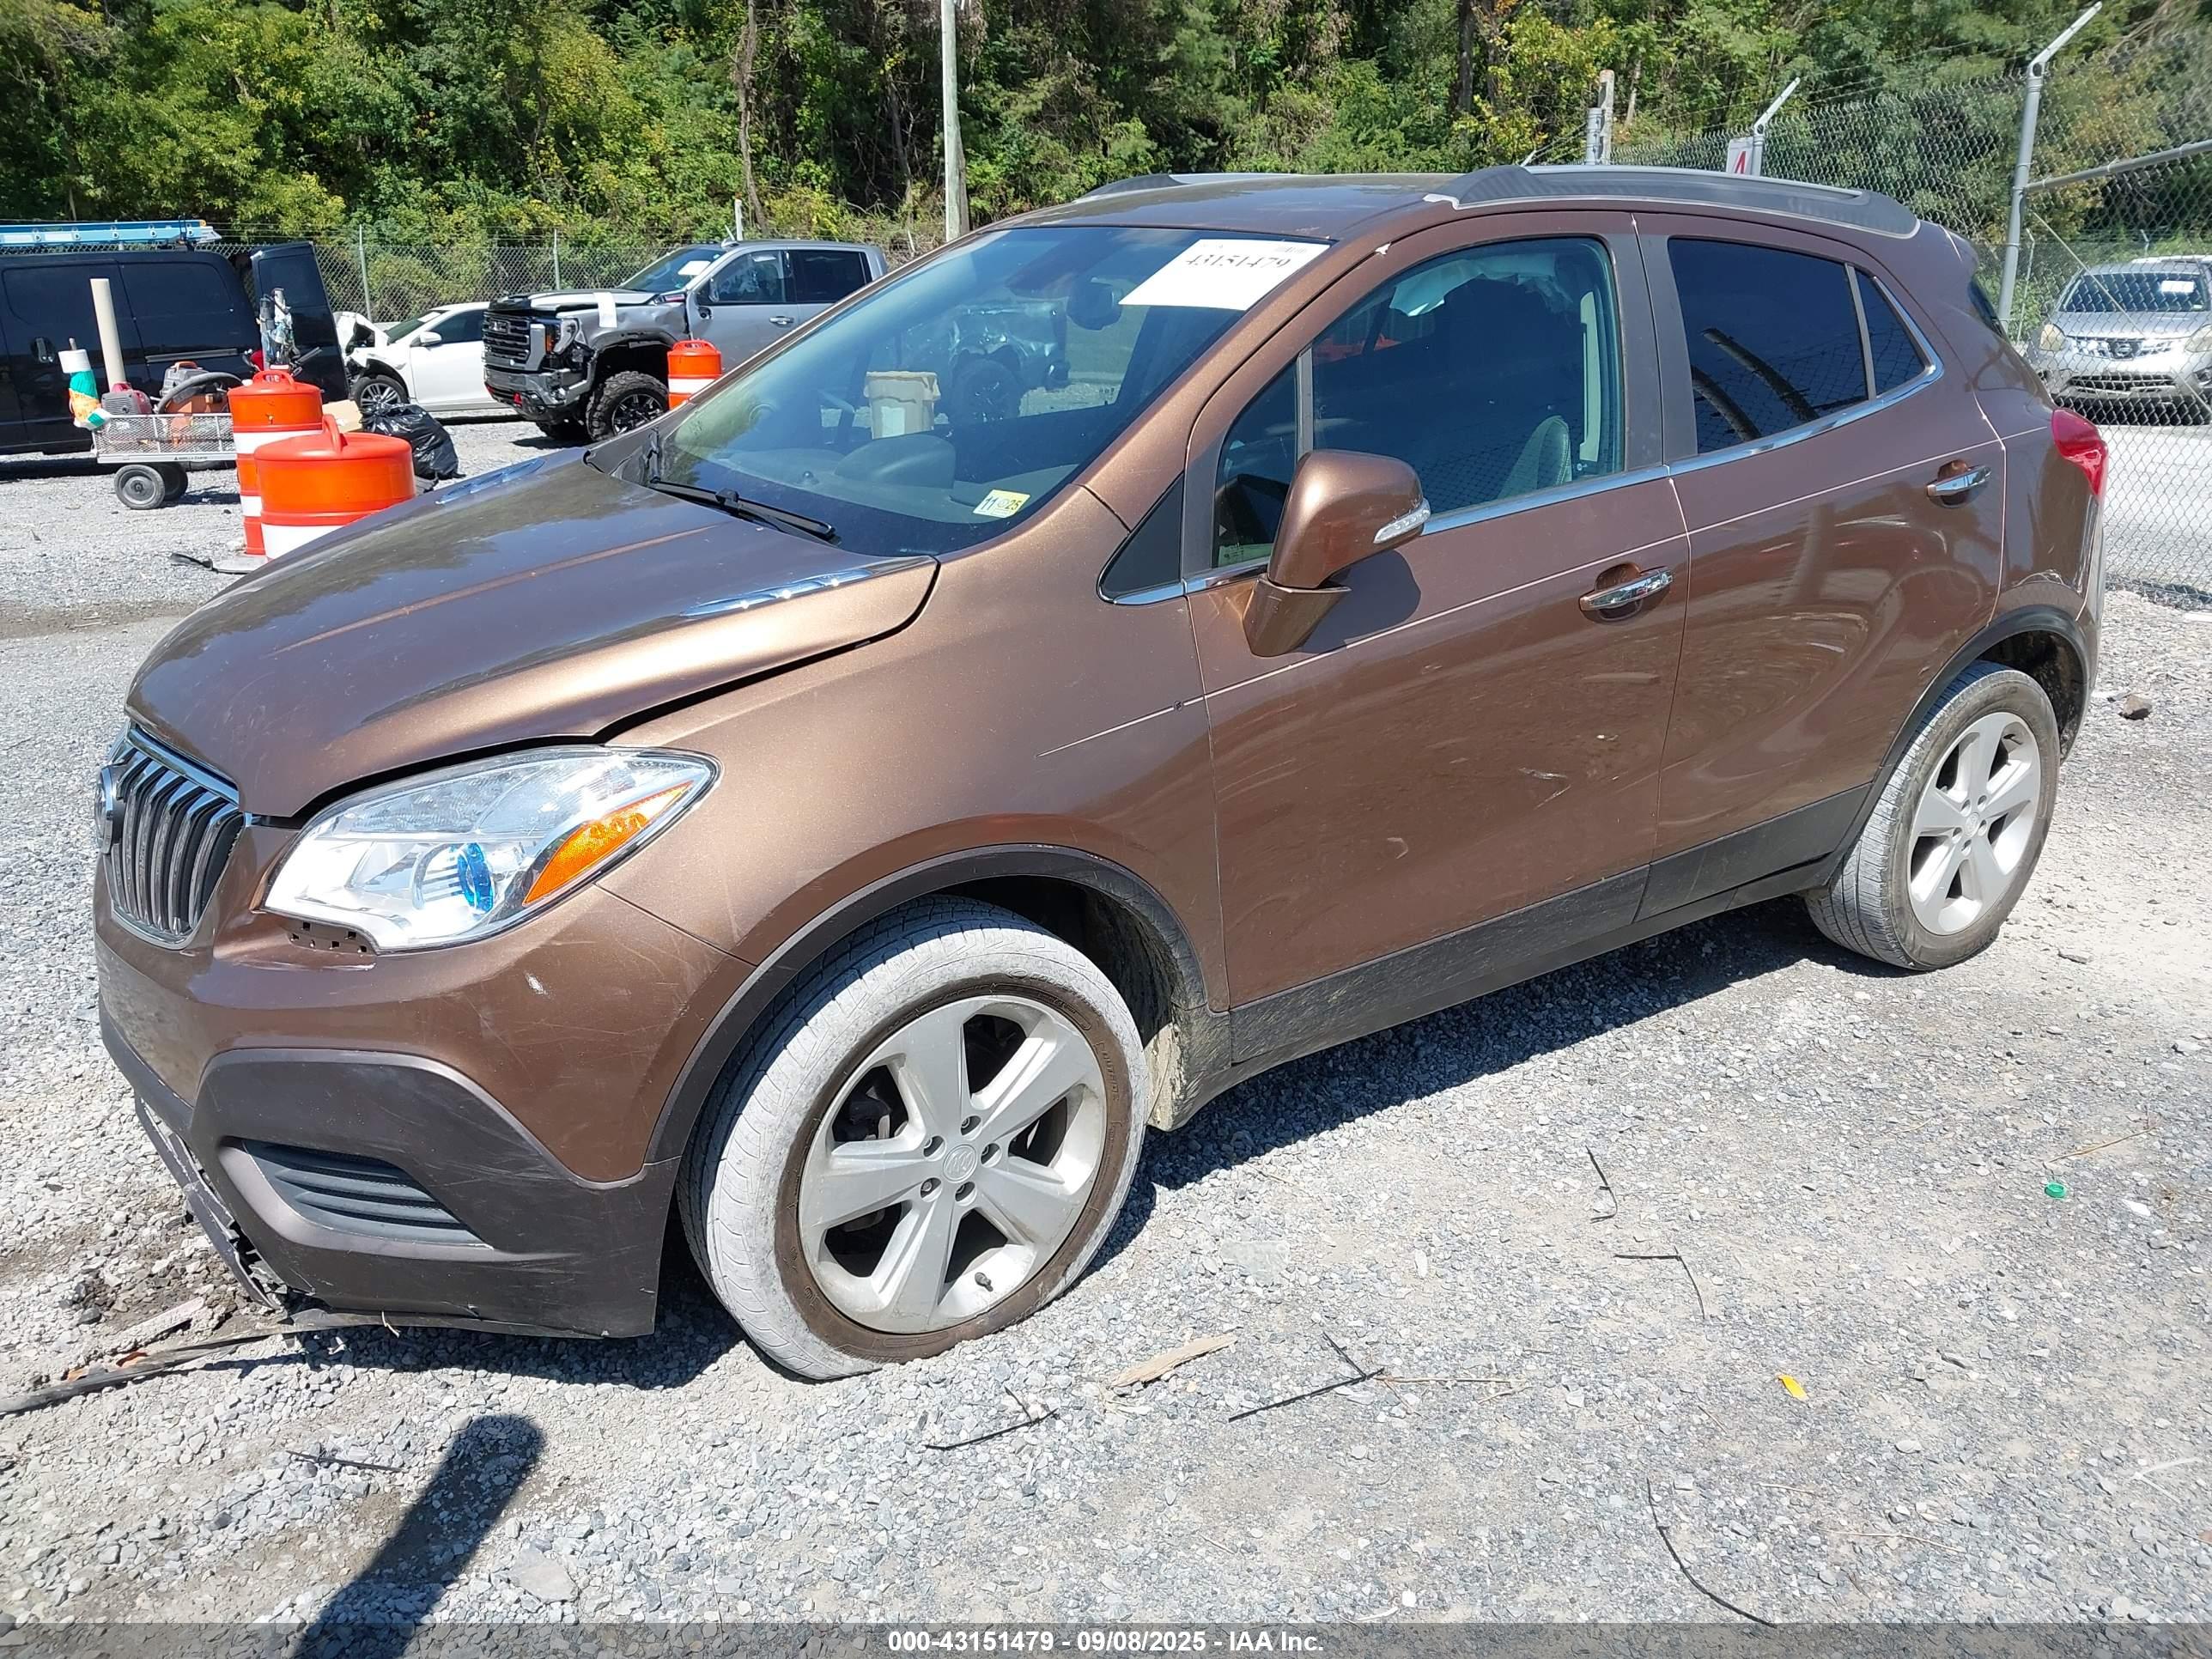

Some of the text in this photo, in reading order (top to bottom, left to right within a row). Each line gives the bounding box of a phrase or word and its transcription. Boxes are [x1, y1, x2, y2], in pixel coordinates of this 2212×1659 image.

[1186, 254, 1291, 268] 43151479
[981, 495, 1022, 511] 11 25
